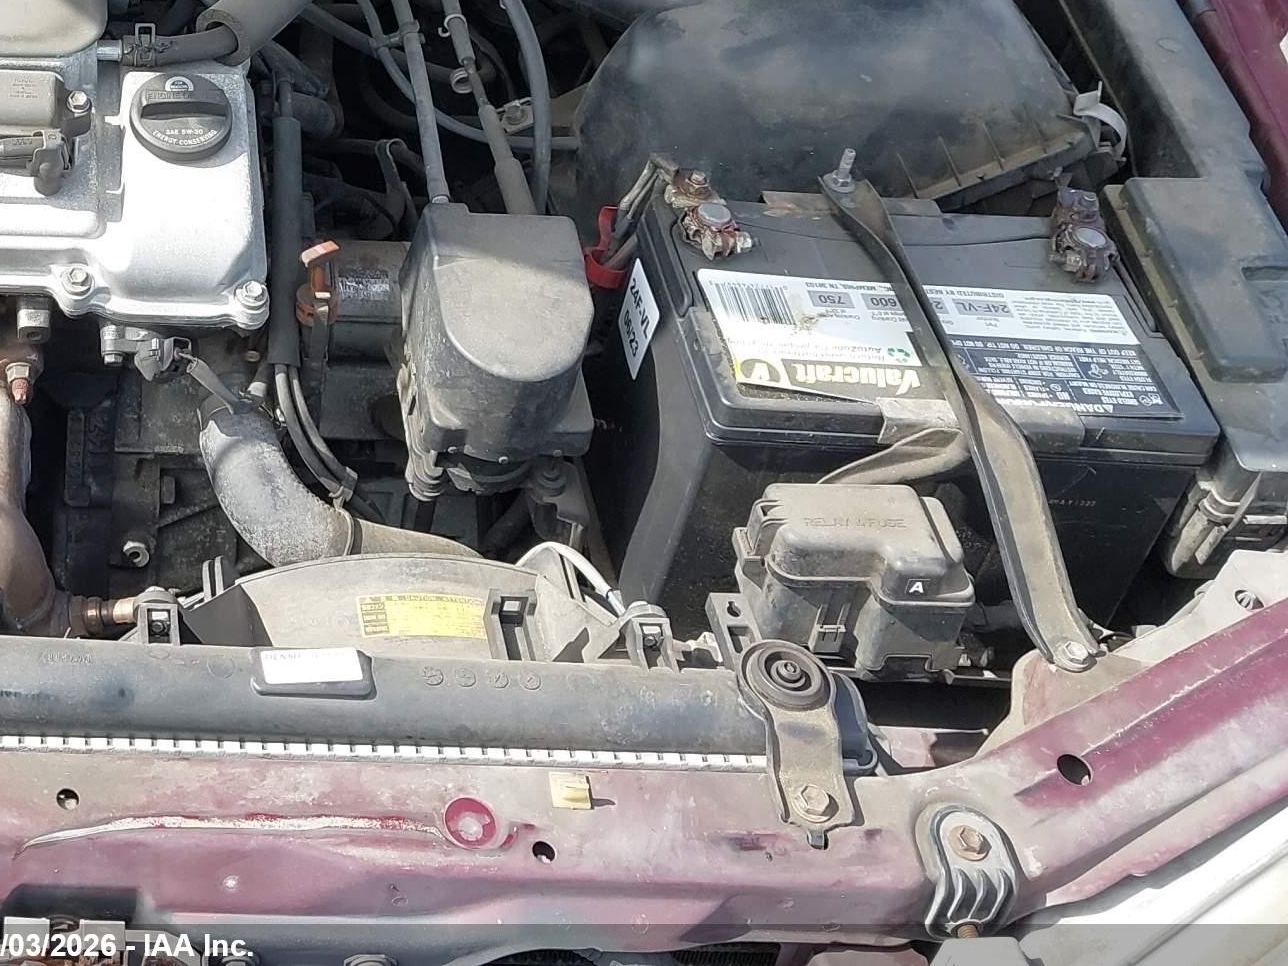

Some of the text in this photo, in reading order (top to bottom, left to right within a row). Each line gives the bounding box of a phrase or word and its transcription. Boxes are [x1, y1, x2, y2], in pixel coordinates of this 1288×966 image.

[152, 129, 218, 146] ENERGY CONSERVING
[818, 294, 845, 305] 750
[957, 290, 1005, 299] DISTRIBUTED
[870, 297, 897, 307] 600
[629, 278, 650, 339] 24F-VL
[956, 302, 1010, 314] 24F-VL
[624, 308, 639, 357] 06/23
[792, 363, 921, 395] Valucraft
[1056, 392, 1071, 401] NO
[1104, 388, 1134, 398] EXPLOSIVE
[1100, 396, 1118, 404] EYES
[1117, 398, 1139, 406] SHIELD
[804, 517, 850, 528] RELAY
[865, 517, 907, 528] FUSE
[909, 581, 924, 594] A
